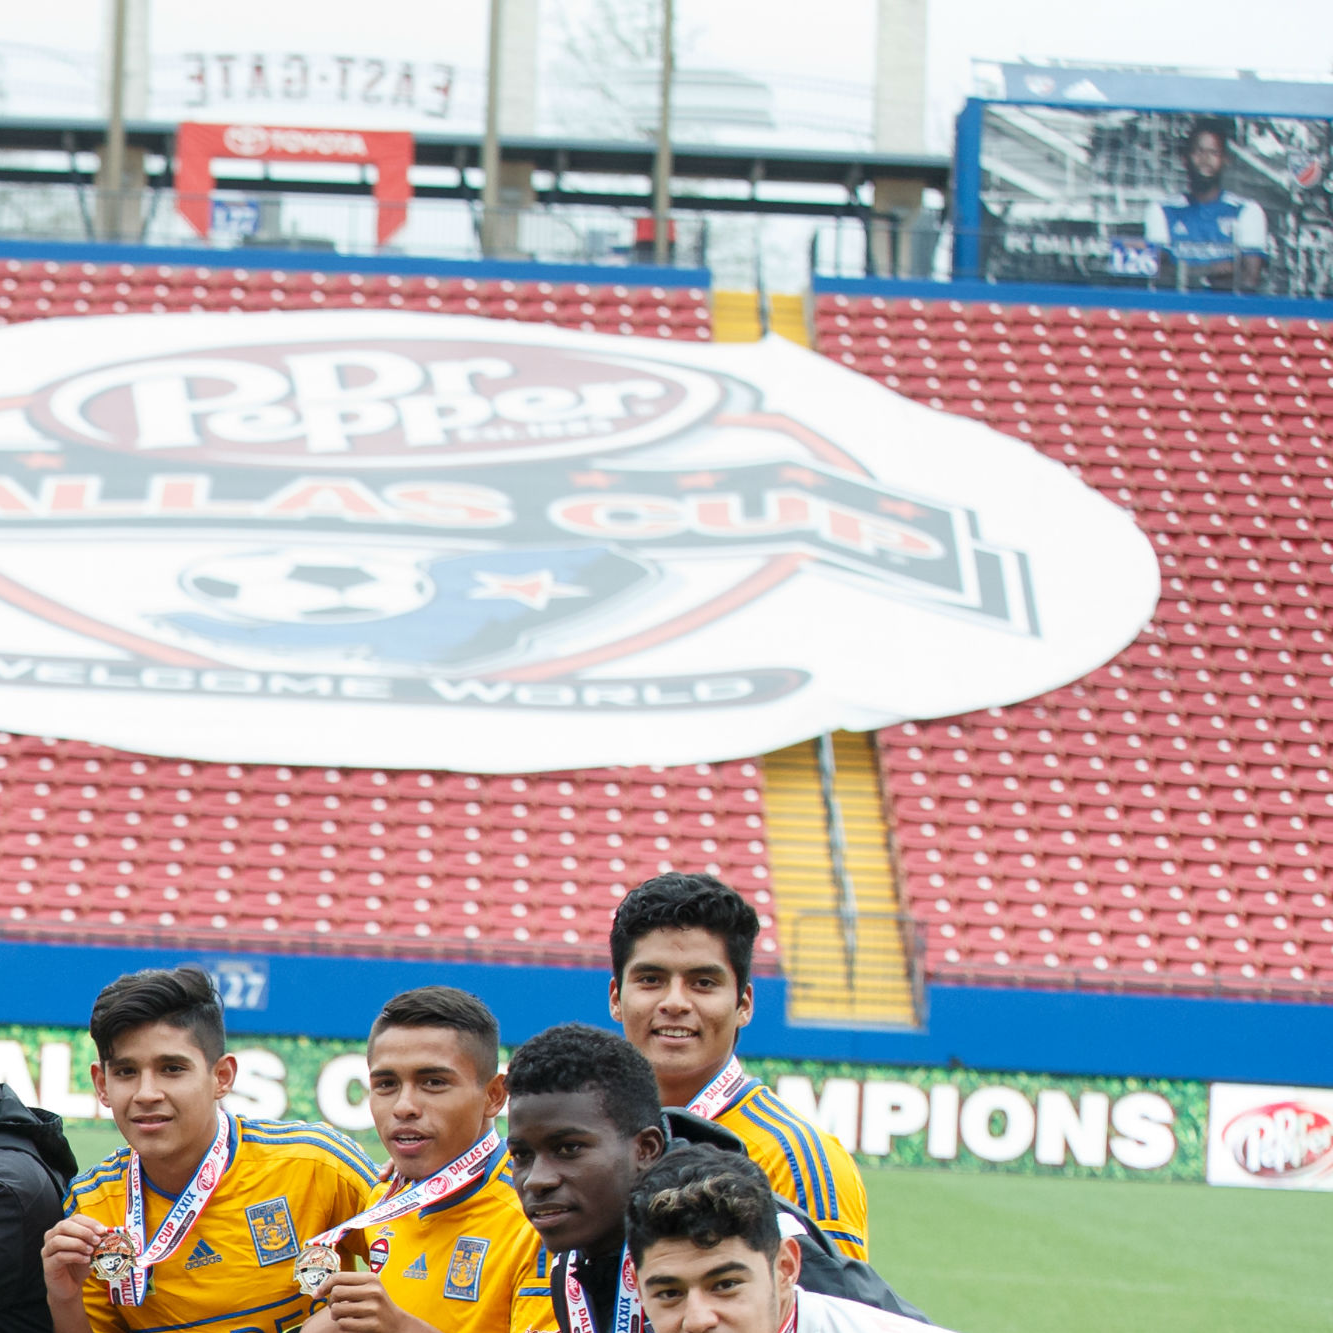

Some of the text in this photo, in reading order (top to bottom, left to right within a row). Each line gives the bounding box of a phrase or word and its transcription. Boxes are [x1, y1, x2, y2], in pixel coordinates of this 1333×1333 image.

[283, 350, 515, 403] Dr
[131, 374, 668, 454] Pepper
[546, 490, 948, 562] CUP
[428, 676, 756, 707] WORLD
[704, 1069, 735, 1101] DALLAS
[449, 1147, 480, 1177] DALLAS
[131, 1171, 142, 1227] CUP XXXIX
[155, 1190, 197, 1247] CUP XXXIX
[184, 1253, 223, 1271] adidas
[617, 1296, 631, 1333] XXXIX
